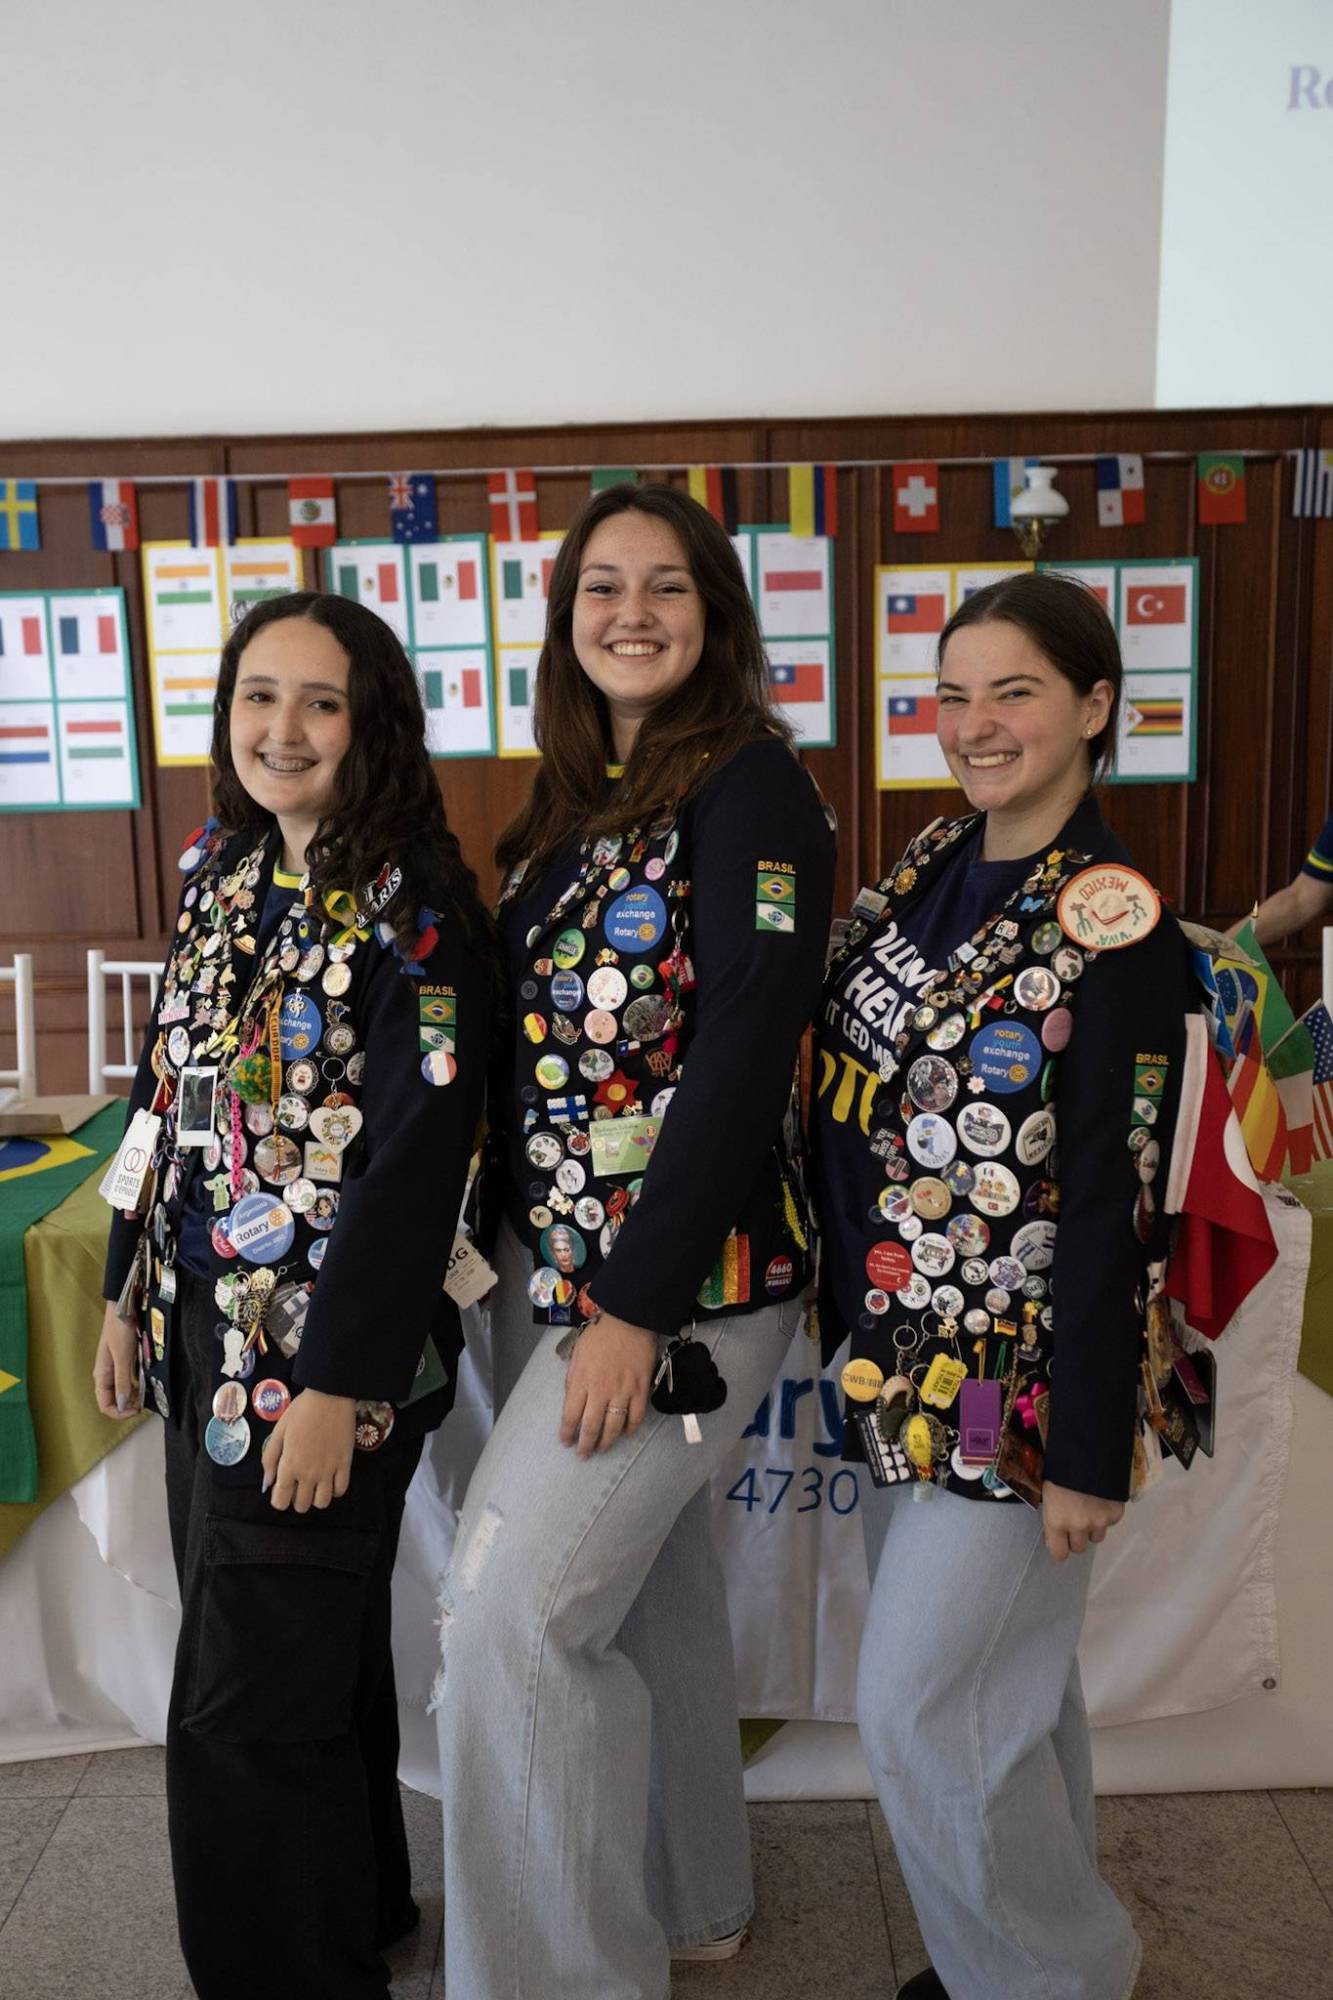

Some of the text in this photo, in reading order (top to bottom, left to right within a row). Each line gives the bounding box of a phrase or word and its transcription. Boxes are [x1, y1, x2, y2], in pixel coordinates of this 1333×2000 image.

[757, 860, 796, 875] BRASIL
[1079, 876, 1129, 901] MEXICO
[616, 910, 656, 920] exchange
[614, 927, 639, 938] Rotary
[419, 985, 457, 996] BRASIL
[842, 1012, 870, 1051] LED
[994, 1029, 1024, 1042] rotary
[982, 1046, 1030, 1062] exchange
[1135, 1053, 1170, 1065] BRASIL
[981, 1063, 1009, 1078] Rotary
[235, 1220, 270, 1245] Rotary
[726, 1467, 859, 1515] 4730
